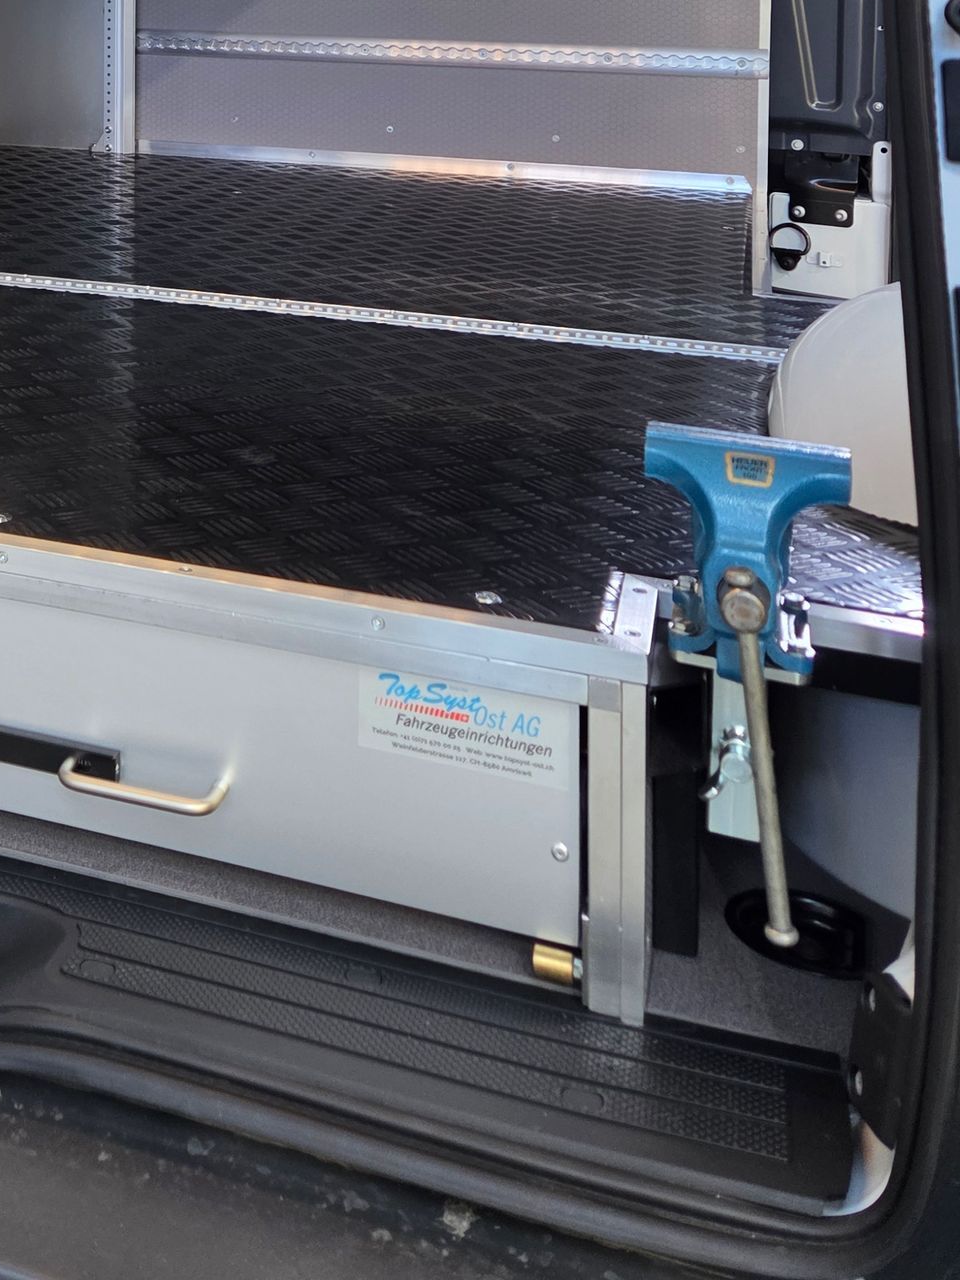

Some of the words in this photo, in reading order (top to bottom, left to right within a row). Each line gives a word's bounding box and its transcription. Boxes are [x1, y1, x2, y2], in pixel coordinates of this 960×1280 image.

[395, 713, 554, 758] Fahrzeugeinrichtungen
[473, 705, 508, 731] Ost
[512, 713, 542, 738] AG
